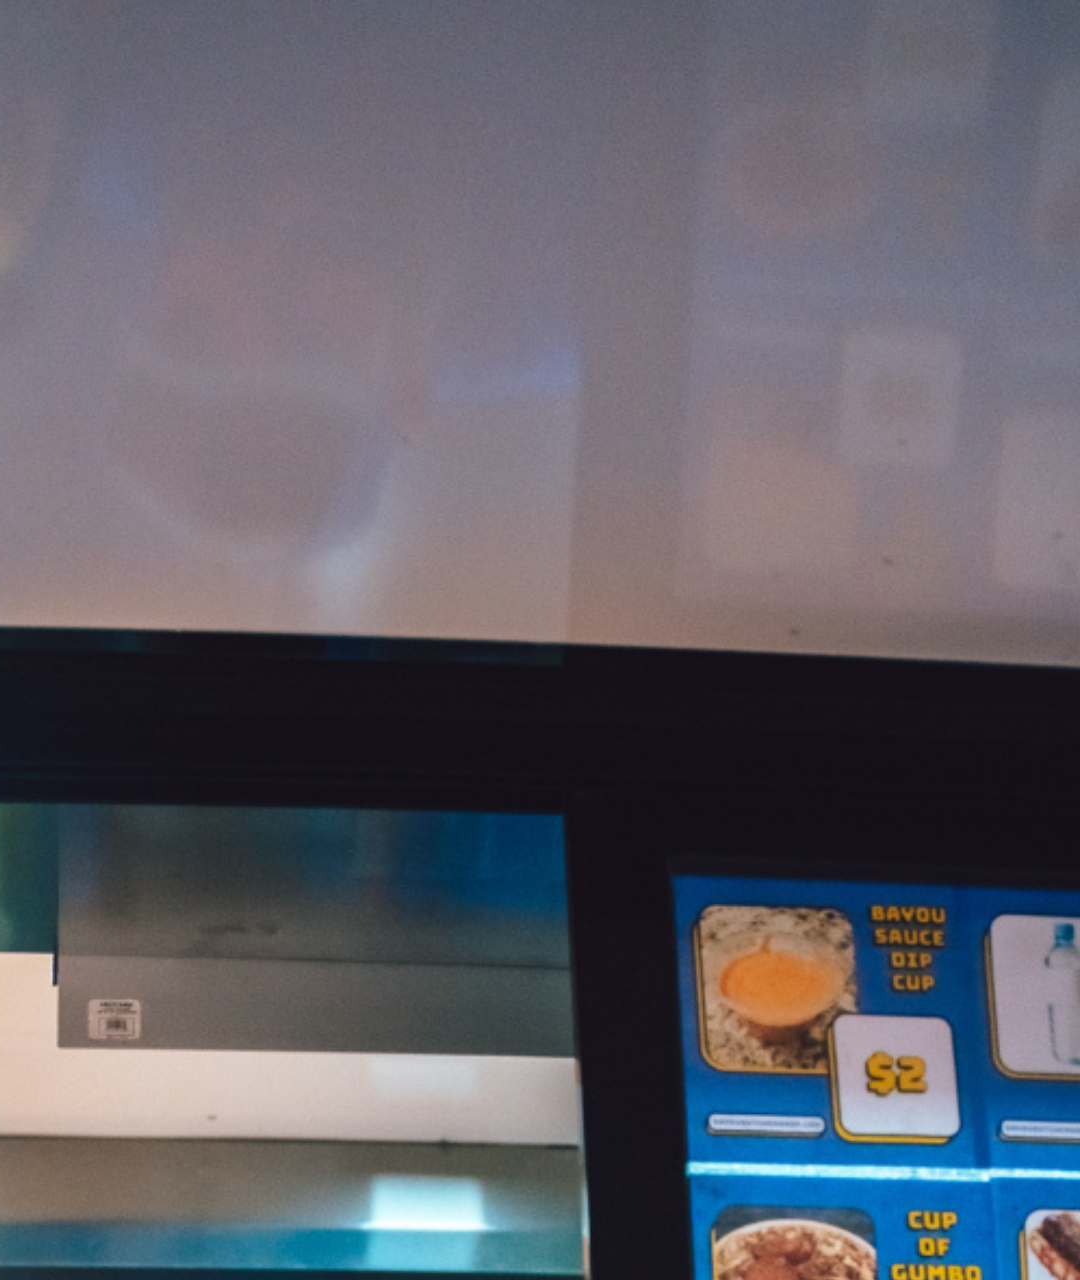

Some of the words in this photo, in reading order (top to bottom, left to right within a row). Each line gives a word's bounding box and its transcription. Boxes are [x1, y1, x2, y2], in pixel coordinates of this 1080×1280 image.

[870, 906, 946, 924] BAYOU
[875, 929, 945, 947] SAUCE
[891, 952, 934, 968] DIP
[892, 974, 936, 992] CUP
[865, 1051, 928, 1096] $2
[908, 1211, 958, 1230] CUP
[918, 1238, 951, 1257] OF
